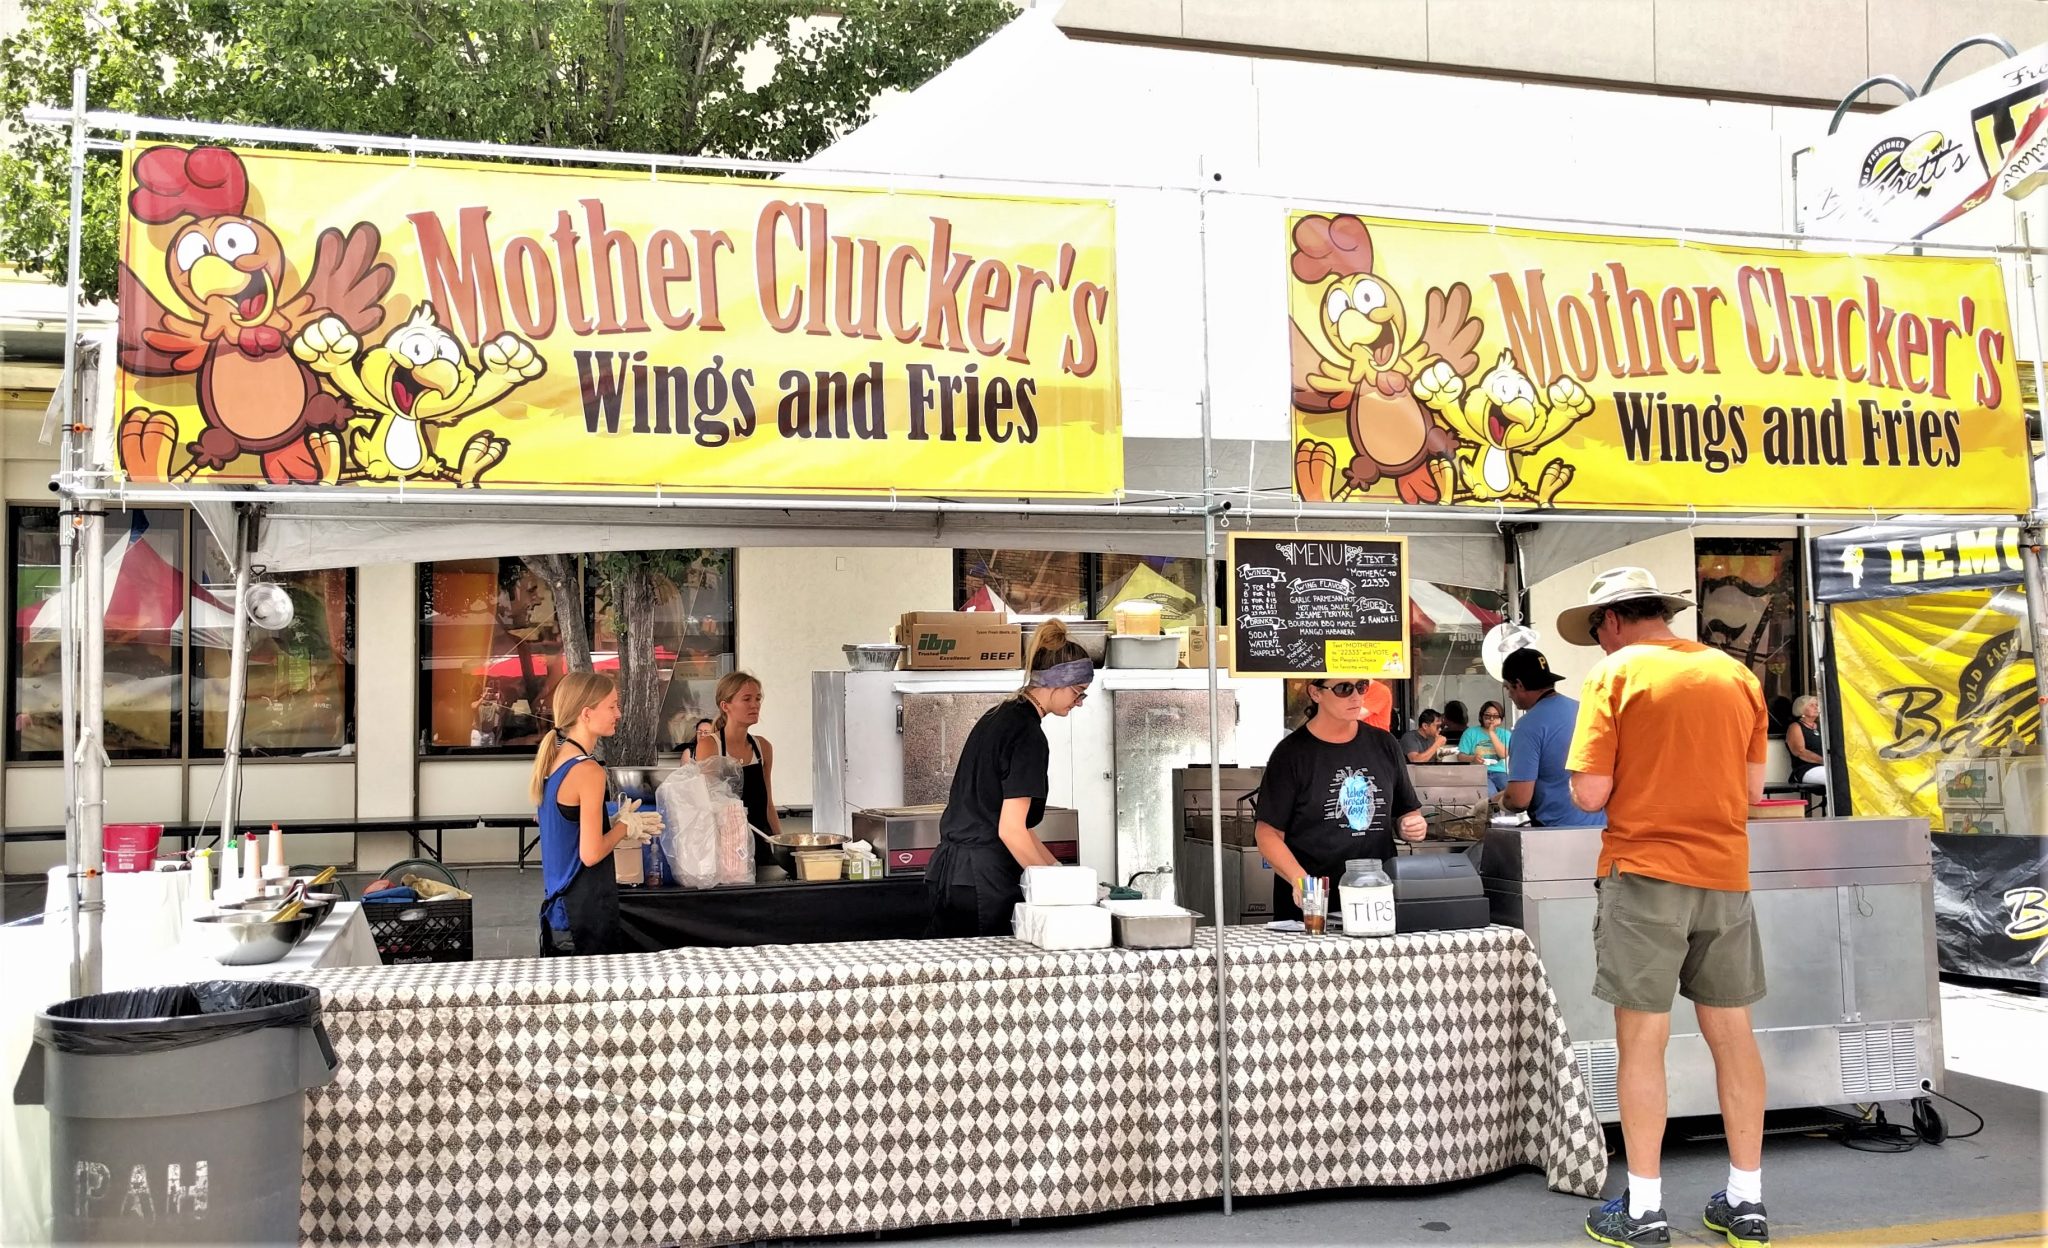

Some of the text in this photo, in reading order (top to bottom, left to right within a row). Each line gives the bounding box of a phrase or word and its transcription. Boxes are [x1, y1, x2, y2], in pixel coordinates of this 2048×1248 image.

[1861, 140, 1906, 185] OLD FASHIONED
[406, 198, 1110, 378] Mother Clucker's
[1489, 262, 2005, 410] Mother Clucker's
[573, 349, 1039, 448] Wings and Fries
[1613, 391, 1961, 473] Wings and Fries
[1294, 543, 1343, 566] MENU
[1364, 555, 1386, 564] TEXT
[1243, 583, 1250, 591] 3
[1297, 580, 1348, 593] WING FLAVORS
[1361, 578, 1390, 588] 22333
[1289, 596, 1311, 604] GARLIC
[1313, 594, 1343, 603] PARMESAN
[1363, 601, 1385, 609] SIDES
[1295, 610, 1354, 620] SESAME TERIYAKI
[1360, 615, 1366, 624] 2
[1367, 615, 1389, 624] RANCH
[1287, 620, 1357, 628] BOURBON BBQ MAPLE
[1248, 630, 1280, 639] SODA $2
[1299, 628, 1324, 636] MANGO
[917, 633, 956, 654] ibp
[1248, 640, 1274, 648] WATER
[1249, 648, 1276, 657] SNAPPLE
[1286, 641, 1308, 660] FORGET
[980, 652, 1015, 661] BEEF
[1295, 654, 1317, 669] THANK
[1310, 657, 1324, 668] YOU
[1537, 656, 1547, 670] P
[1966, 668, 1983, 703] OLD
[1349, 897, 1394, 922] TIPS
